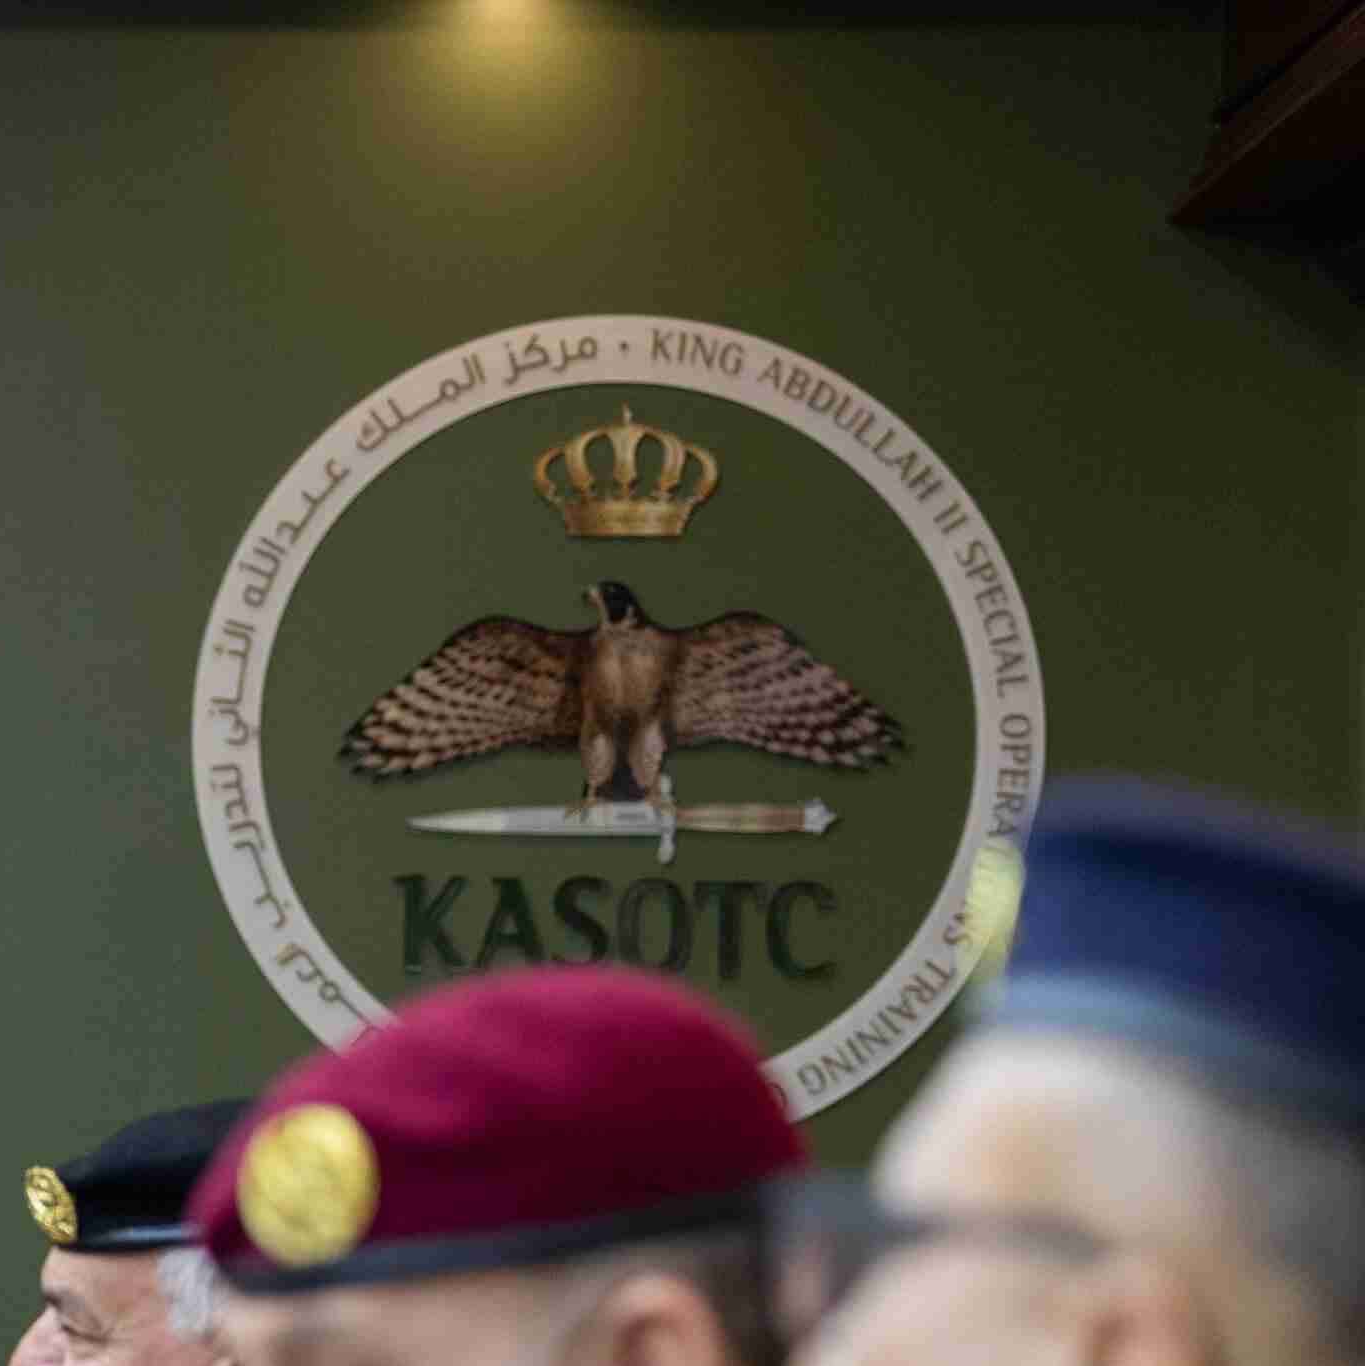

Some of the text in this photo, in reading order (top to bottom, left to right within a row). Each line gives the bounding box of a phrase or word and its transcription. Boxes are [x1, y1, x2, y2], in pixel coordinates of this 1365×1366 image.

[503, 332, 599, 386] مركز
[649, 327, 1032, 1096] KING ABDULLAH II SPECIAL OPERAS TRAINING
[391, 873, 837, 981] KASOTC
